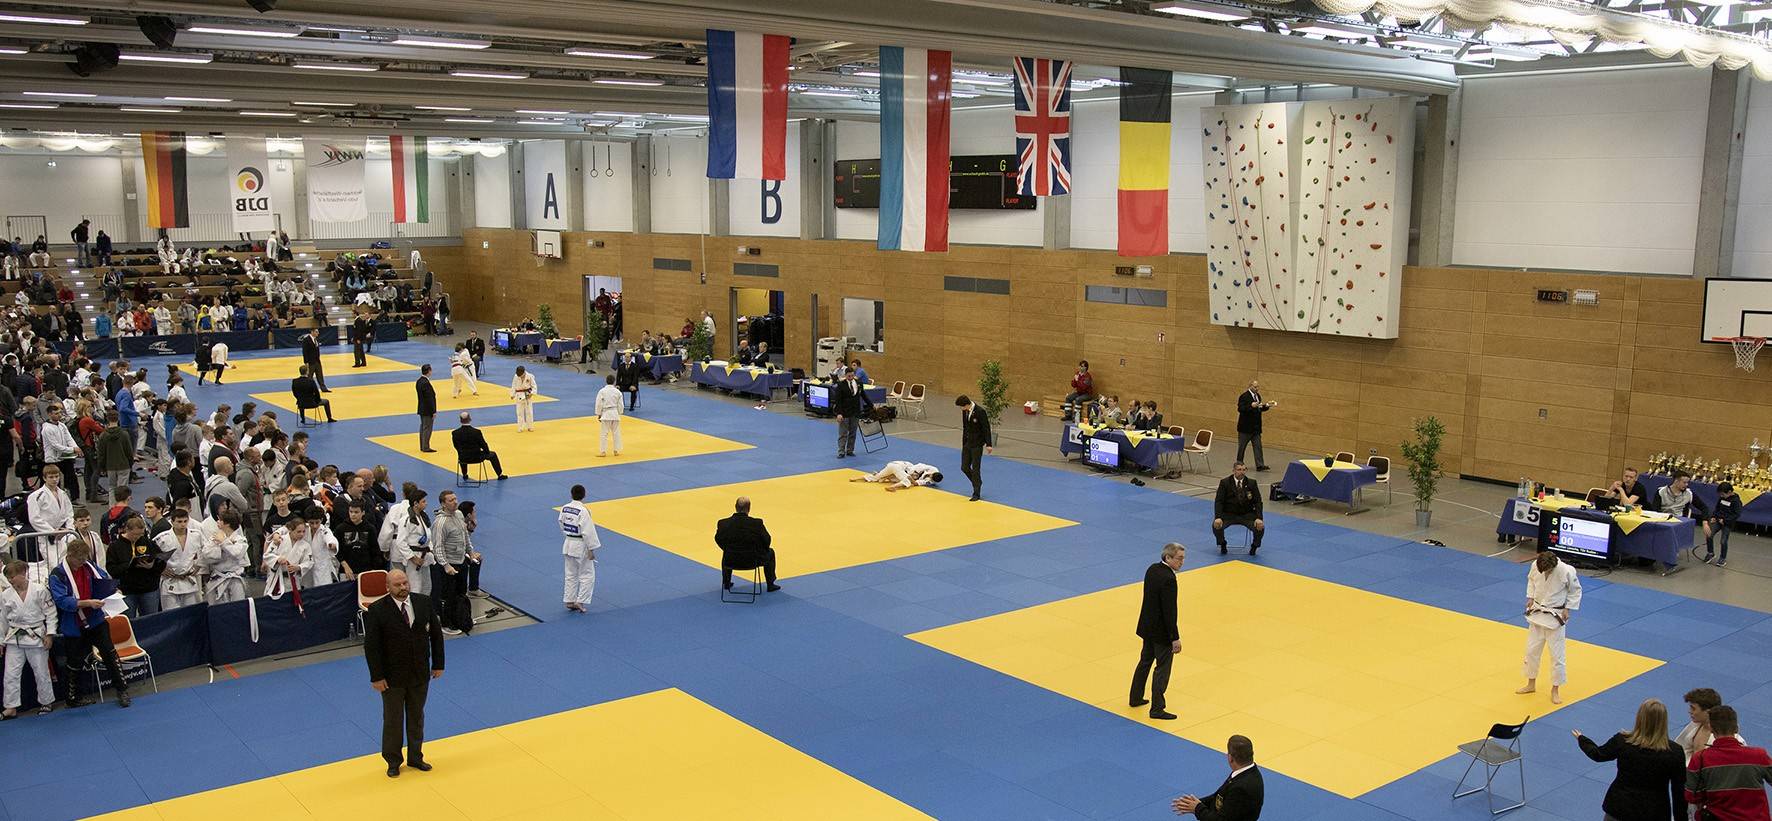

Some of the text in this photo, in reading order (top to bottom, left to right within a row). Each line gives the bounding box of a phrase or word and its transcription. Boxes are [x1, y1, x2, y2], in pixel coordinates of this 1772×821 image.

[851, 164, 857, 174] H
[999, 159, 1006, 171] G
[543, 173, 559, 219] A
[761, 179, 782, 224] B
[1077, 430, 1084, 442] 4
[1527, 506, 1540, 523] 5
[1551, 517, 1558, 525] 5
[1562, 522, 1574, 531] 01
[1561, 536, 1574, 546] 00
